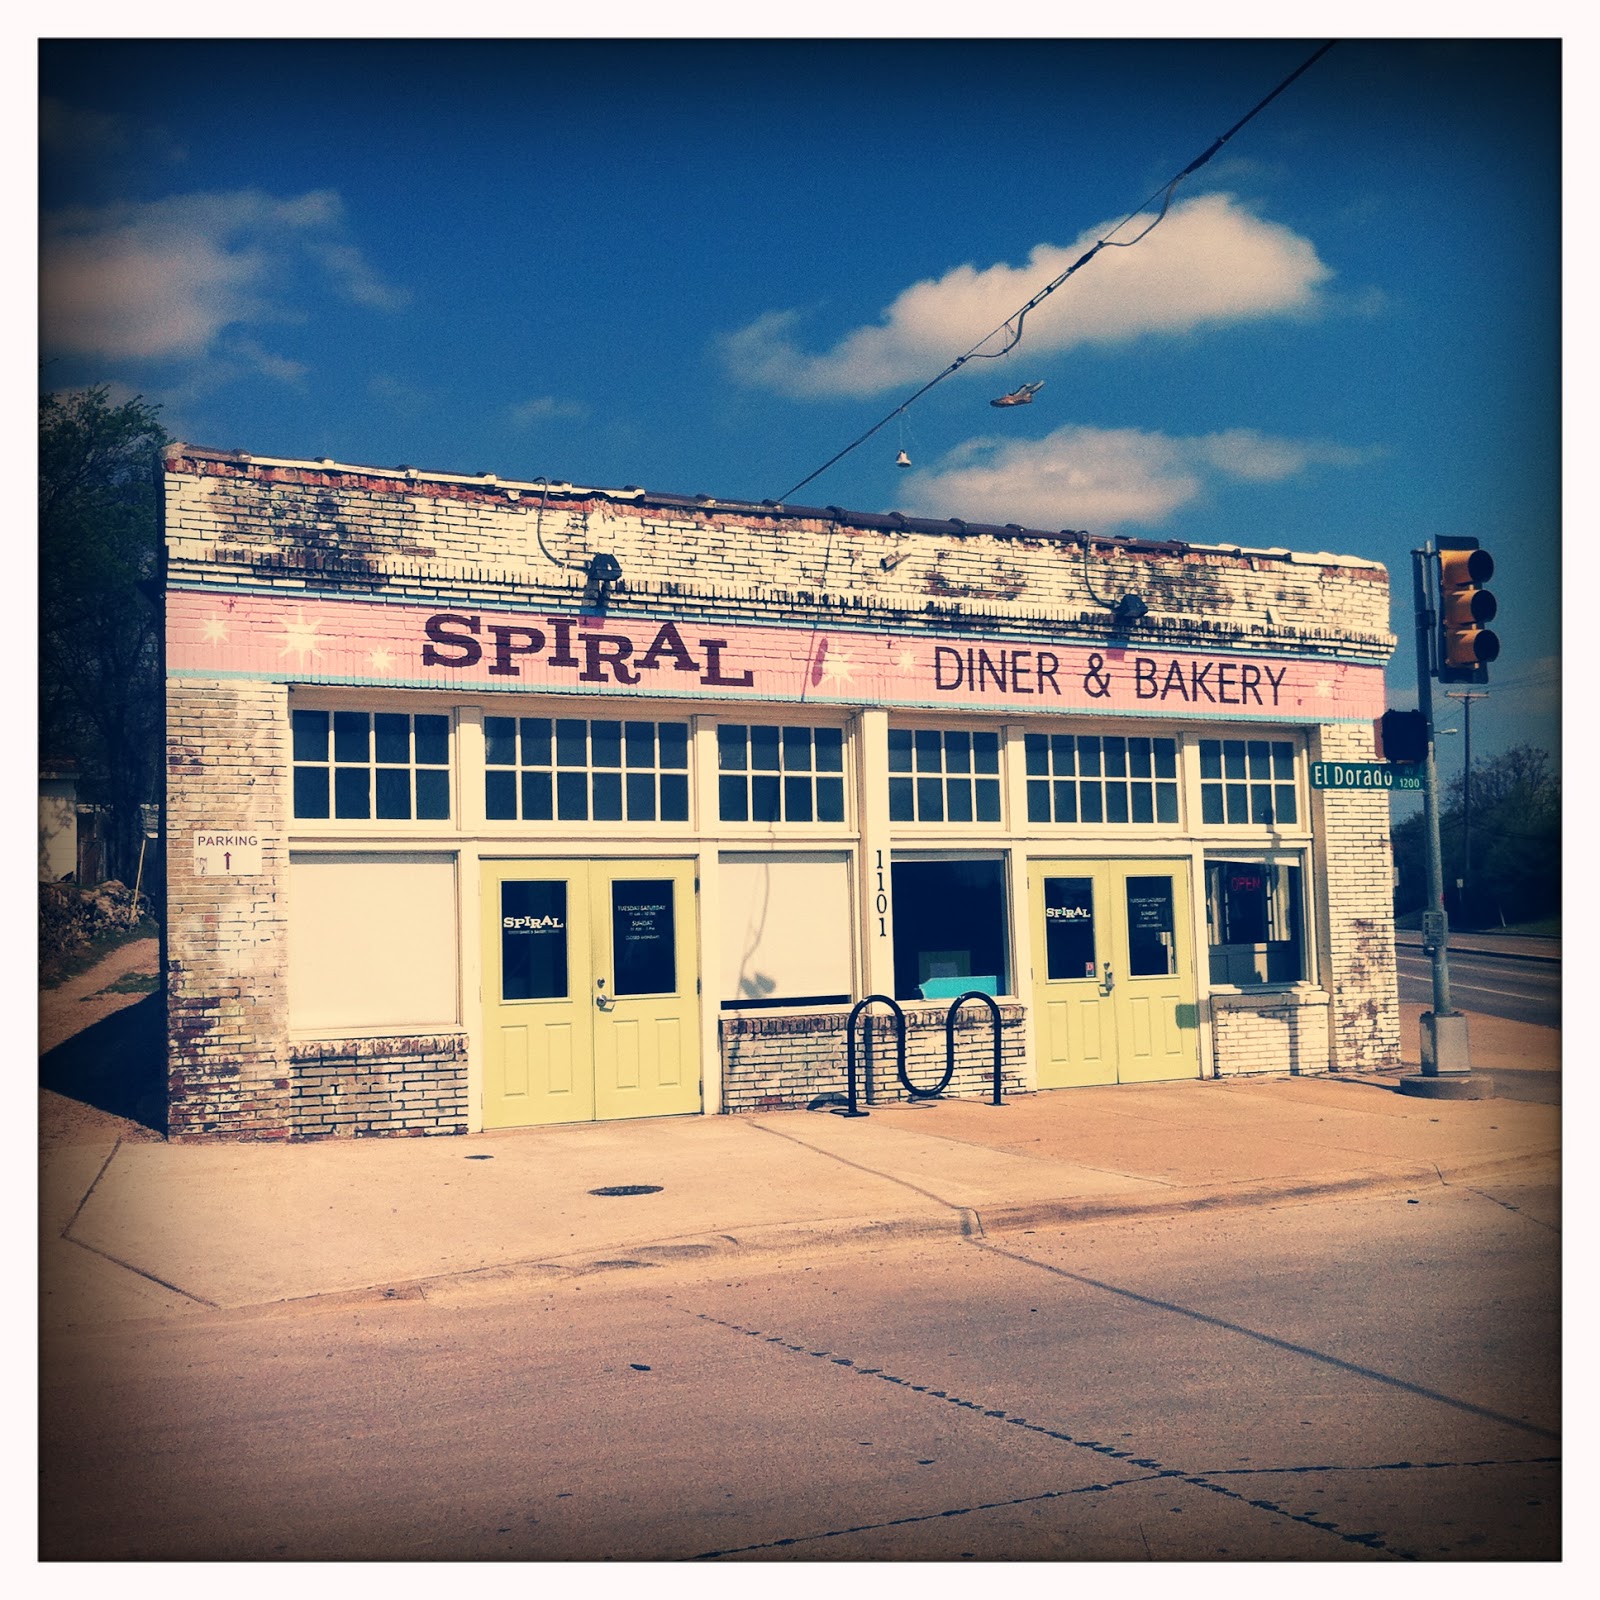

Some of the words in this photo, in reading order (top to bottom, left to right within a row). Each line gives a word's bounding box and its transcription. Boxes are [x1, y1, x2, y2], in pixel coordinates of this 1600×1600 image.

[423, 614, 754, 687] SPIRAL
[935, 646, 1062, 695] DINER
[1083, 653, 1111, 698] &
[1135, 657, 1287, 706] BAKERY
[1315, 765, 1329, 785] El
[1335, 766, 1393, 786] Dorado
[1400, 778, 1420, 788] 1200
[198, 836, 258, 846] PARKING
[1232, 877, 1262, 892] OPEN
[876, 850, 887, 937] 1101
[1046, 906, 1091, 918] SPIRAL
[503, 915, 564, 929] SPIRAL
